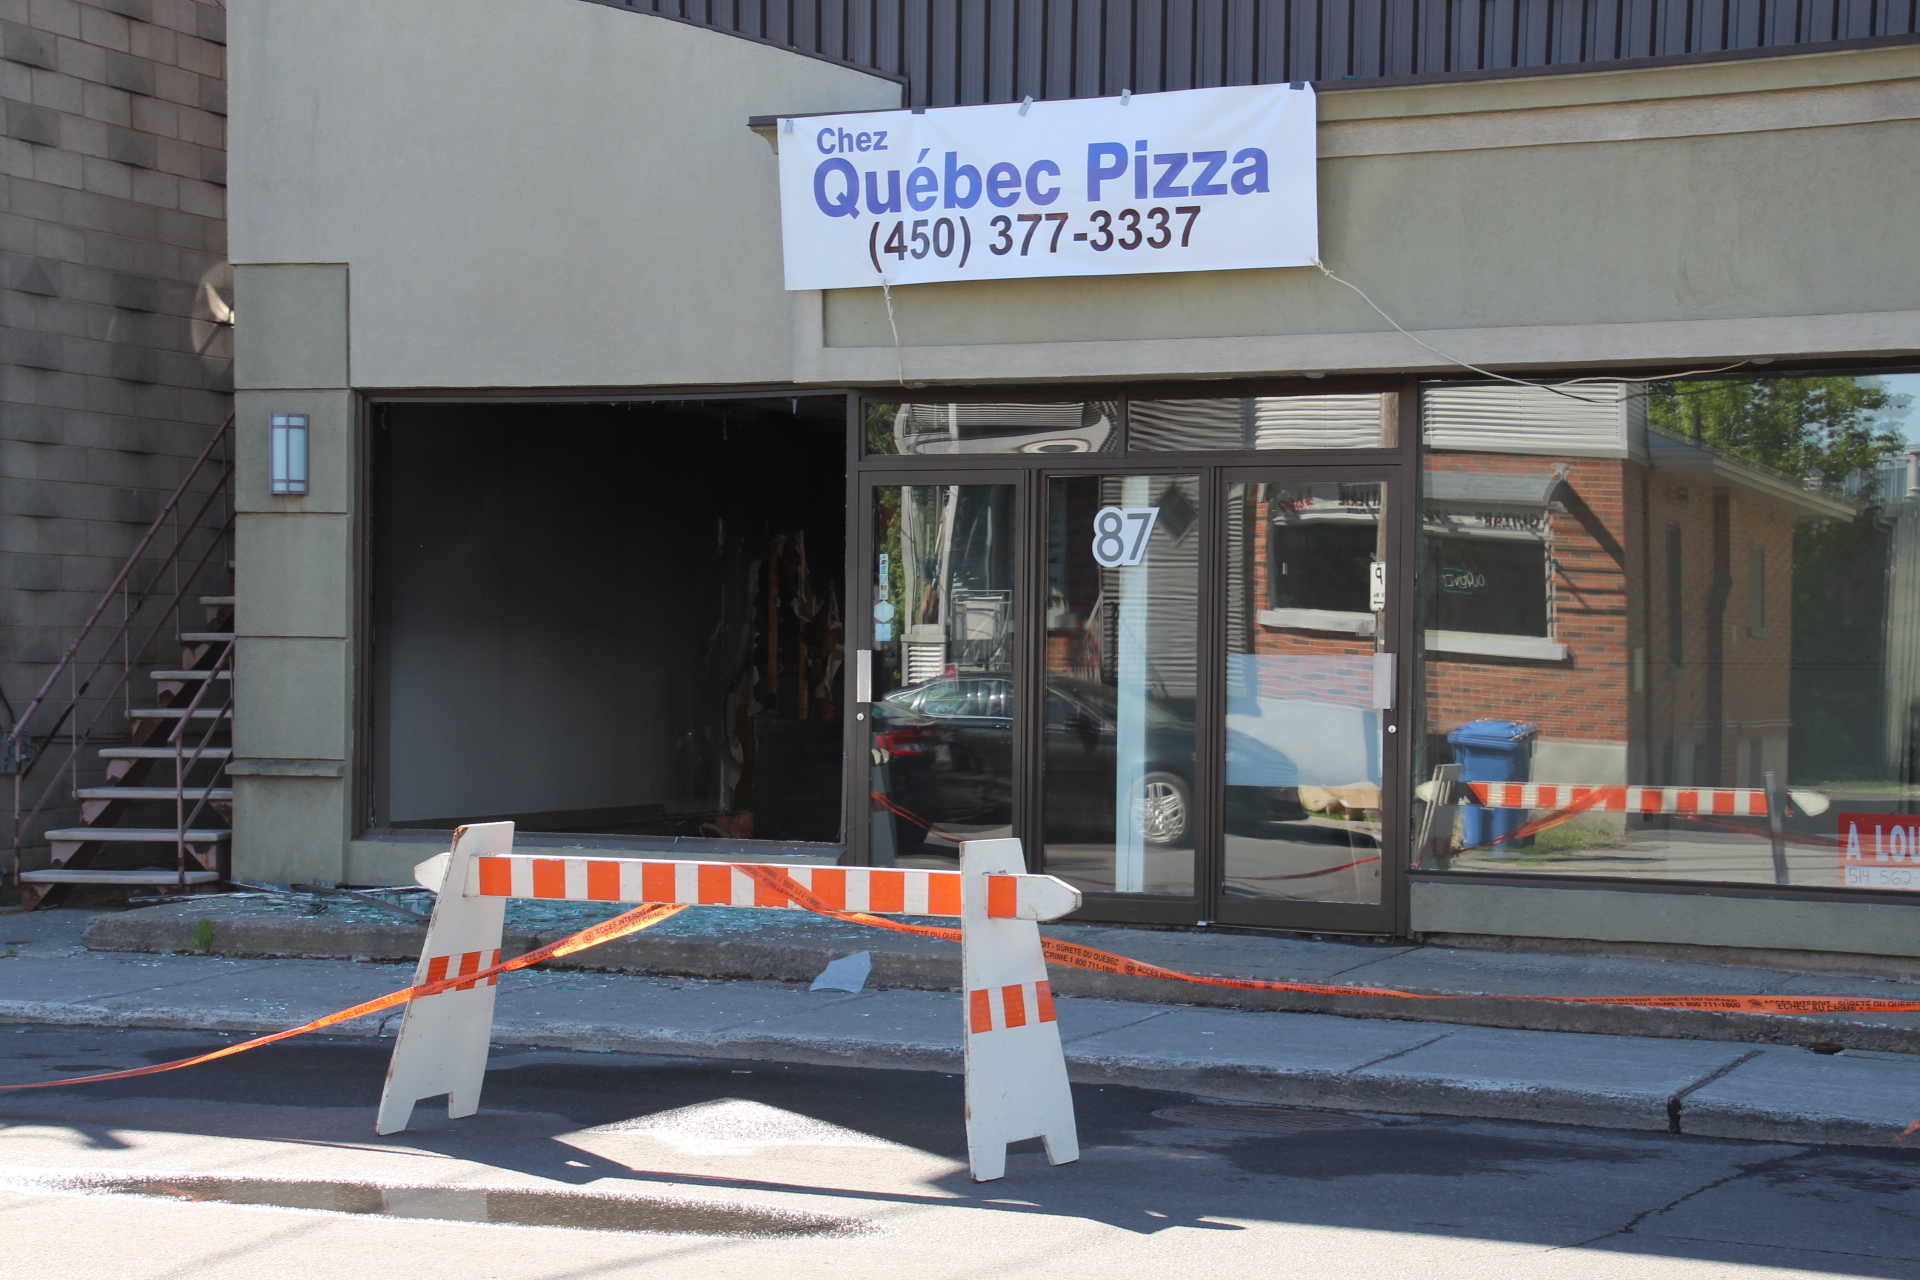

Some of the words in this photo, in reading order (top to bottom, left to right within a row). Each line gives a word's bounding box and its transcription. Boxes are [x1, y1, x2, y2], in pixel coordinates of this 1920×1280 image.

[816, 127, 888, 154] Chez
[813, 148, 1062, 220] Québec
[1086, 140, 1271, 202] Pizza
[869, 215, 972, 273] (450)
[988, 205, 1201, 257] 377-3337
[1096, 511, 1153, 563] 87
[1846, 820, 1862, 861] À
[643, 908, 666, 923] CRIME
[1044, 950, 1068, 962] CRIME
[1074, 958, 1087, 967] 800
[1056, 943, 1082, 956] SÛRETÉ
[1083, 950, 1093, 959] DU
[1093, 952, 1119, 966] QUÉBEC
